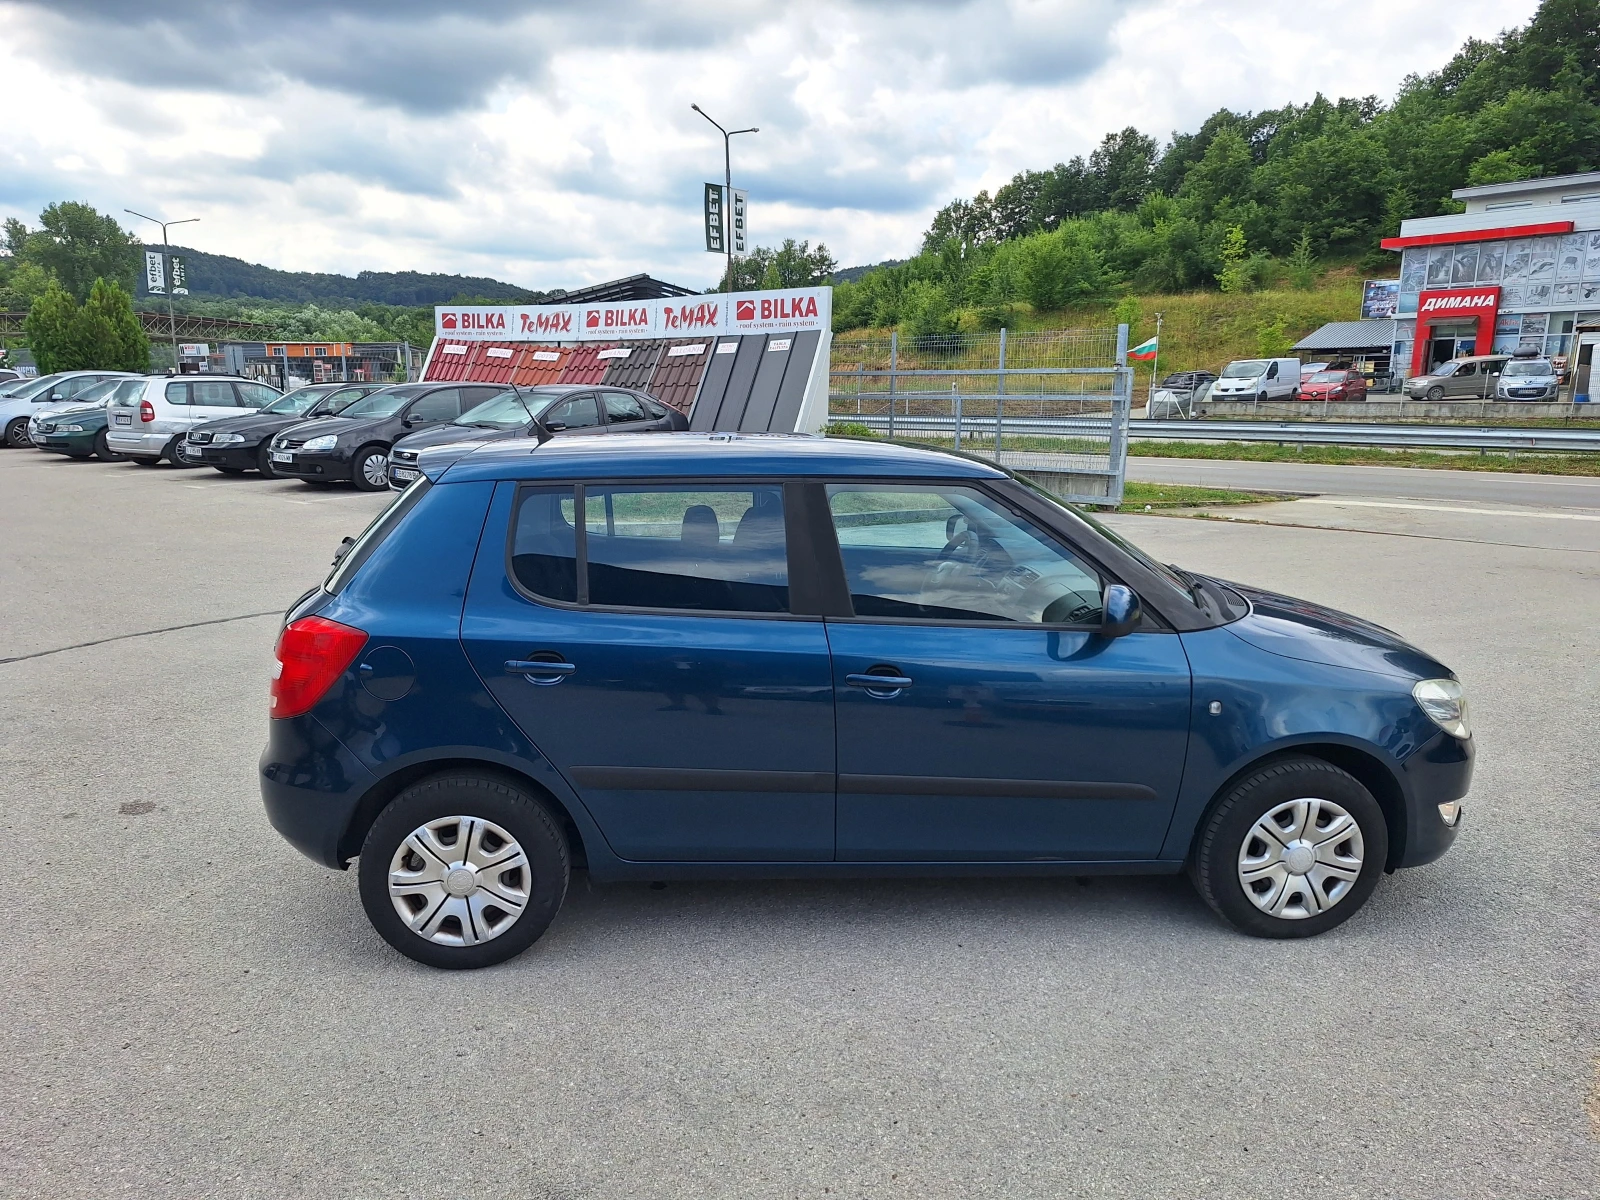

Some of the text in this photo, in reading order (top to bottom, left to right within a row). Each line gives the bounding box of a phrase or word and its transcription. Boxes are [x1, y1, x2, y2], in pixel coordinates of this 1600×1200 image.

[149, 255, 157, 282] efbet
[172, 257, 180, 286] efbet
[760, 296, 818, 320] BILKA
[1420, 294, 1495, 312] ДИМАНА
[462, 313, 506, 329] BILKA
[520, 312, 572, 335] TeMAX
[604, 308, 648, 327] BILKA
[664, 304, 719, 331] TeMAX
[753, 322, 774, 330] system
[792, 320, 815, 328] system
